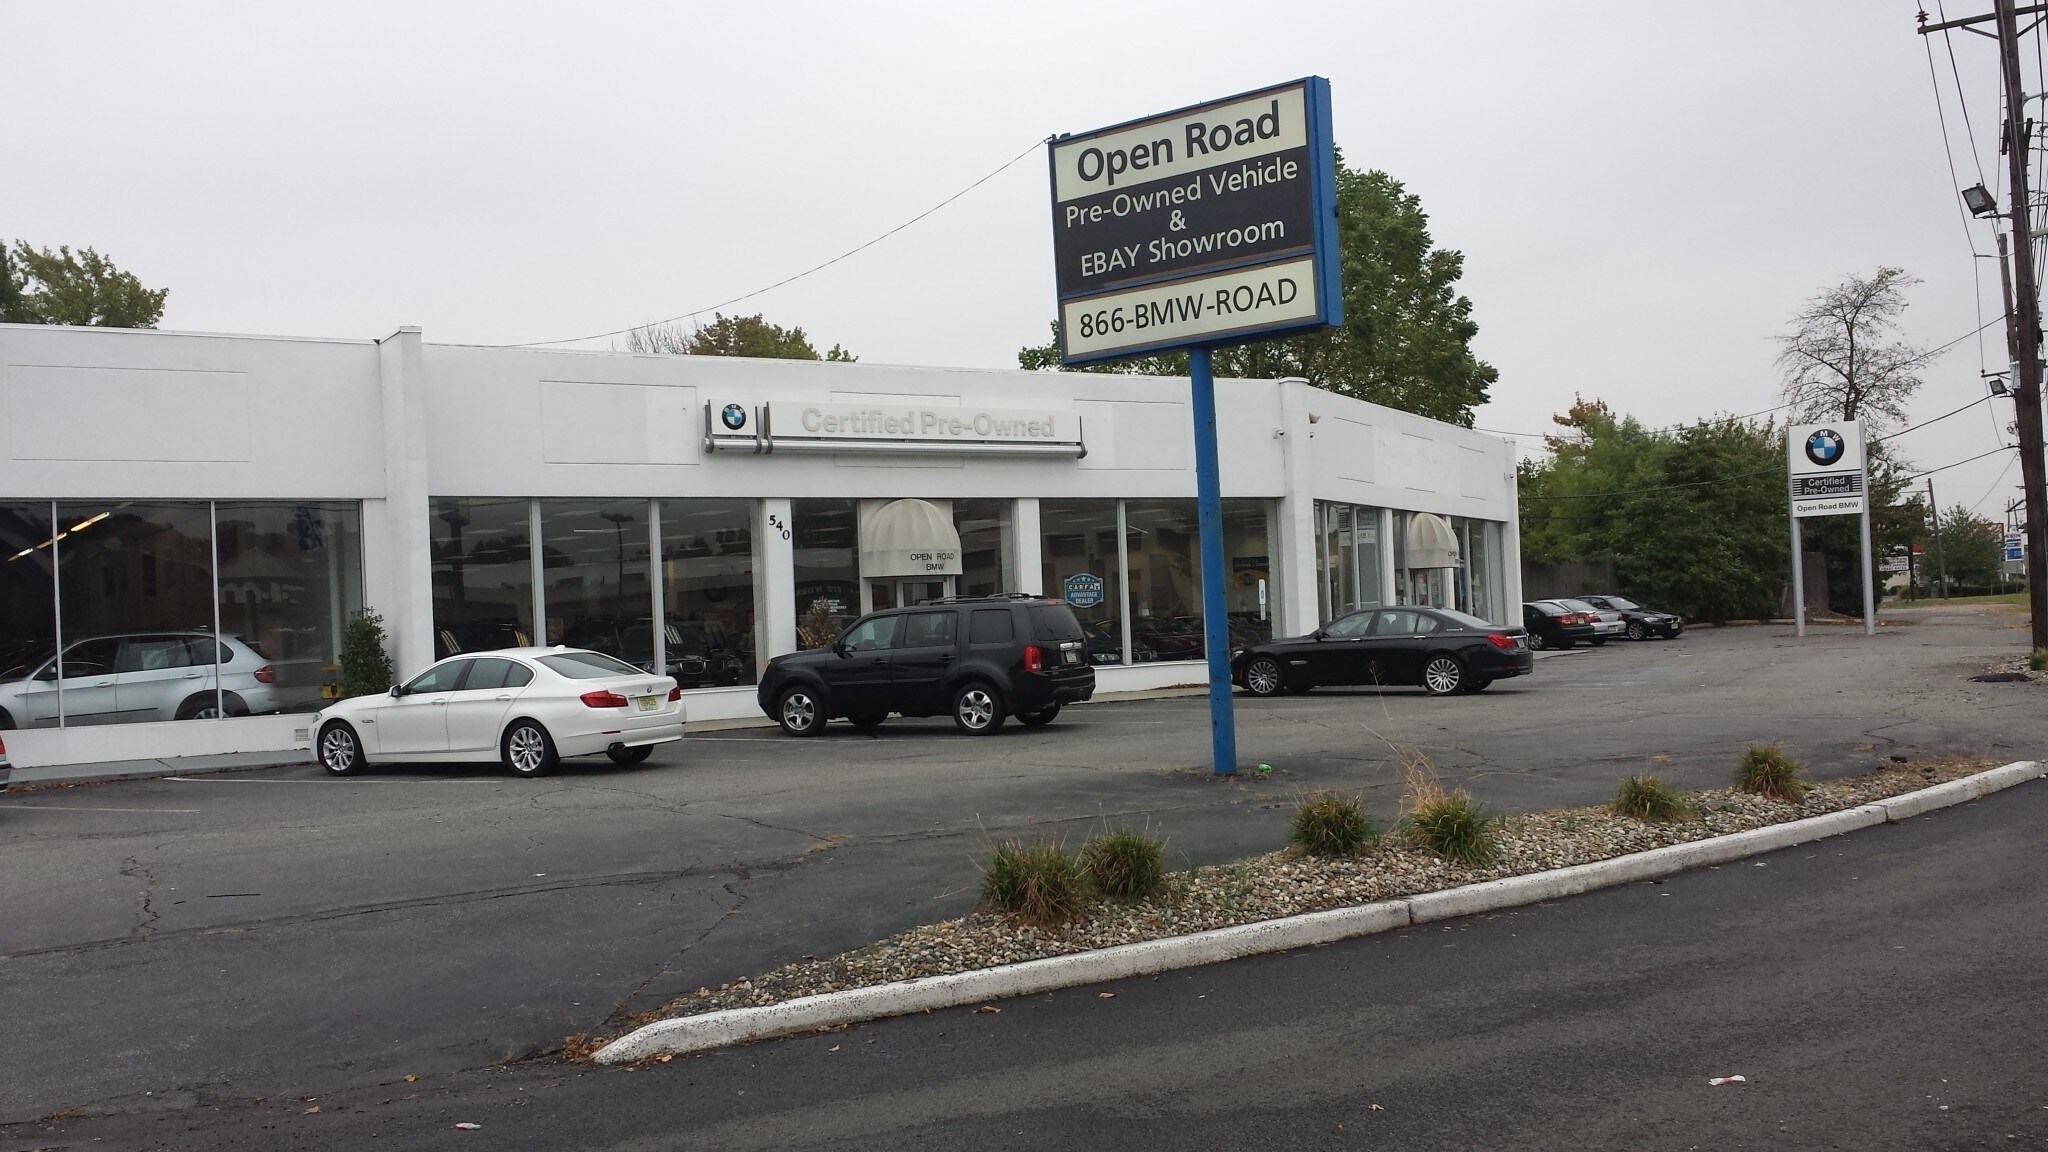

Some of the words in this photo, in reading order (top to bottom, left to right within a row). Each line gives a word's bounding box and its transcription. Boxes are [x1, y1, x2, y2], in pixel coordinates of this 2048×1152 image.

[1077, 138, 1173, 186] Open
[1185, 100, 1280, 158] Road
[1066, 176, 1201, 228] Pre-Owned
[1209, 157, 1298, 195] Vehicle
[1169, 209, 1187, 231] &
[1081, 244, 1140, 277] EBAY
[1149, 219, 1285, 263] Showroom
[1080, 278, 1297, 338] 866-BMW-ROAD
[801, 407, 915, 434] Certified
[920, 411, 1055, 437] Pre-Owned
[1809, 430, 1840, 443] BMW
[1804, 484, 1850, 495] Pre-Owned
[1808, 476, 1845, 487] Certified
[1797, 504, 1817, 512] Open
[769, 514, 790, 540] 540
[910, 552, 932, 561] OPEN
[936, 552, 954, 560] ROAD
[926, 563, 944, 571] BMW
[1070, 591, 1099, 599] ADVANTAGE
